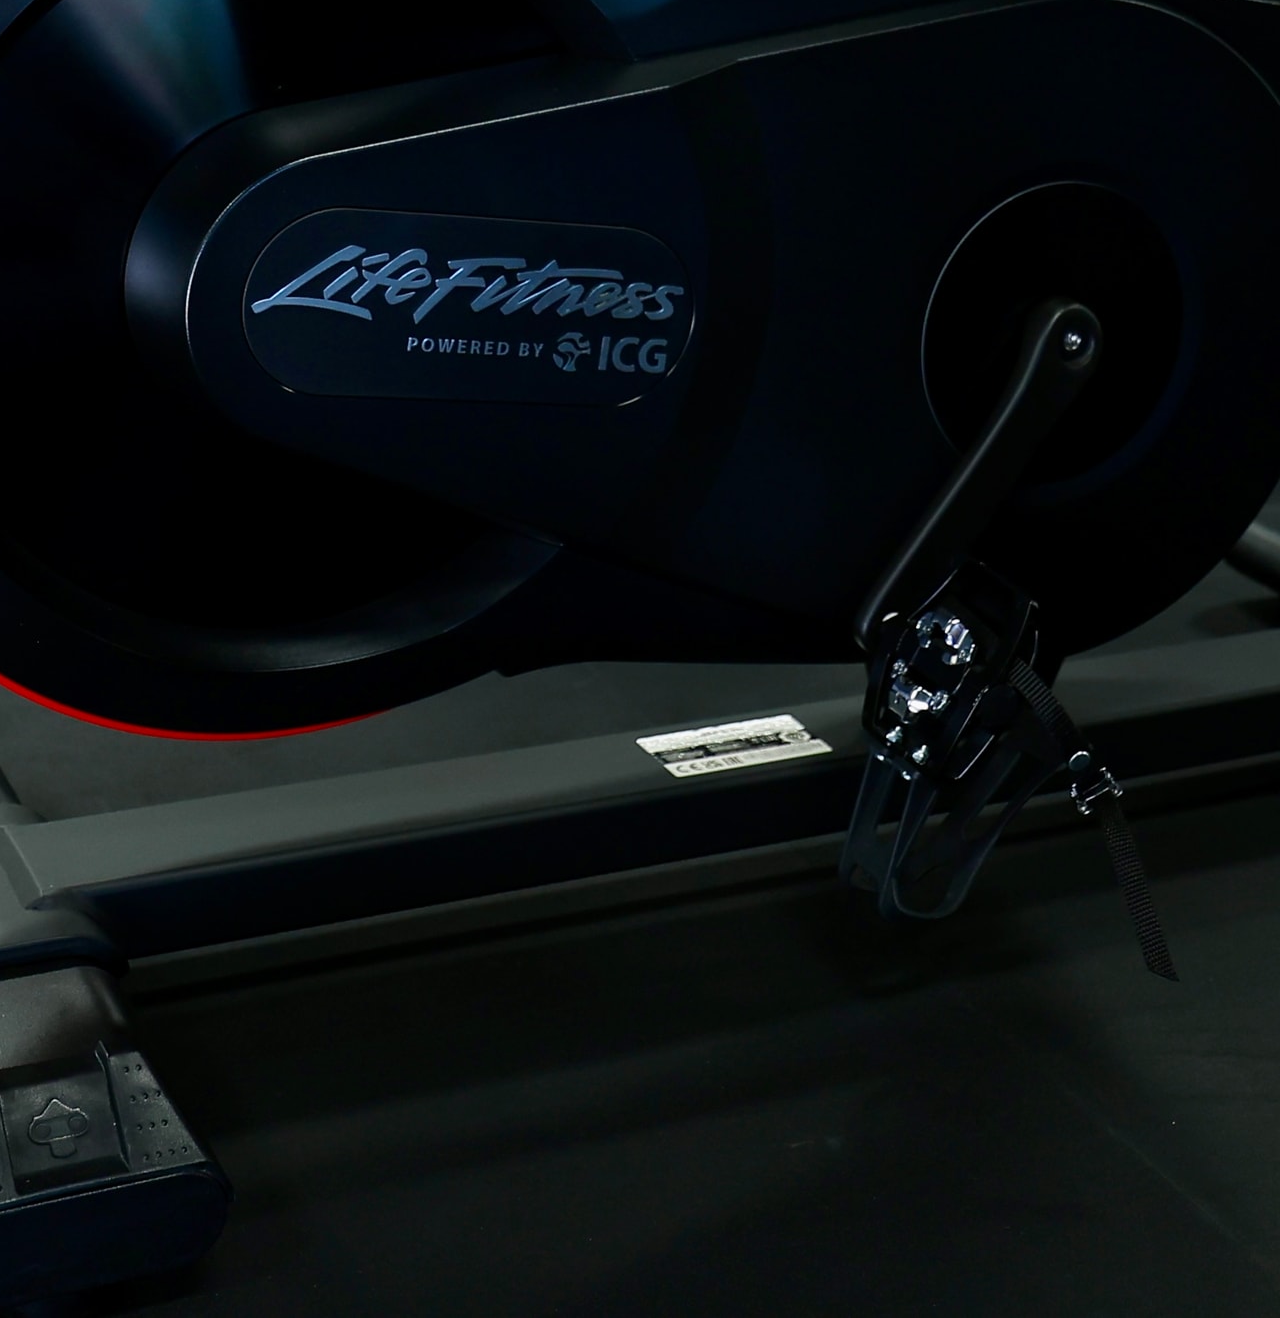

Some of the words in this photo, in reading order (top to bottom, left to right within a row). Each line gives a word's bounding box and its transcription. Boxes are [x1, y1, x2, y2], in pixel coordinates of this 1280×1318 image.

[406, 336, 511, 357] POWERED
[518, 342, 545, 359] BY
[597, 335, 670, 374] ICG
